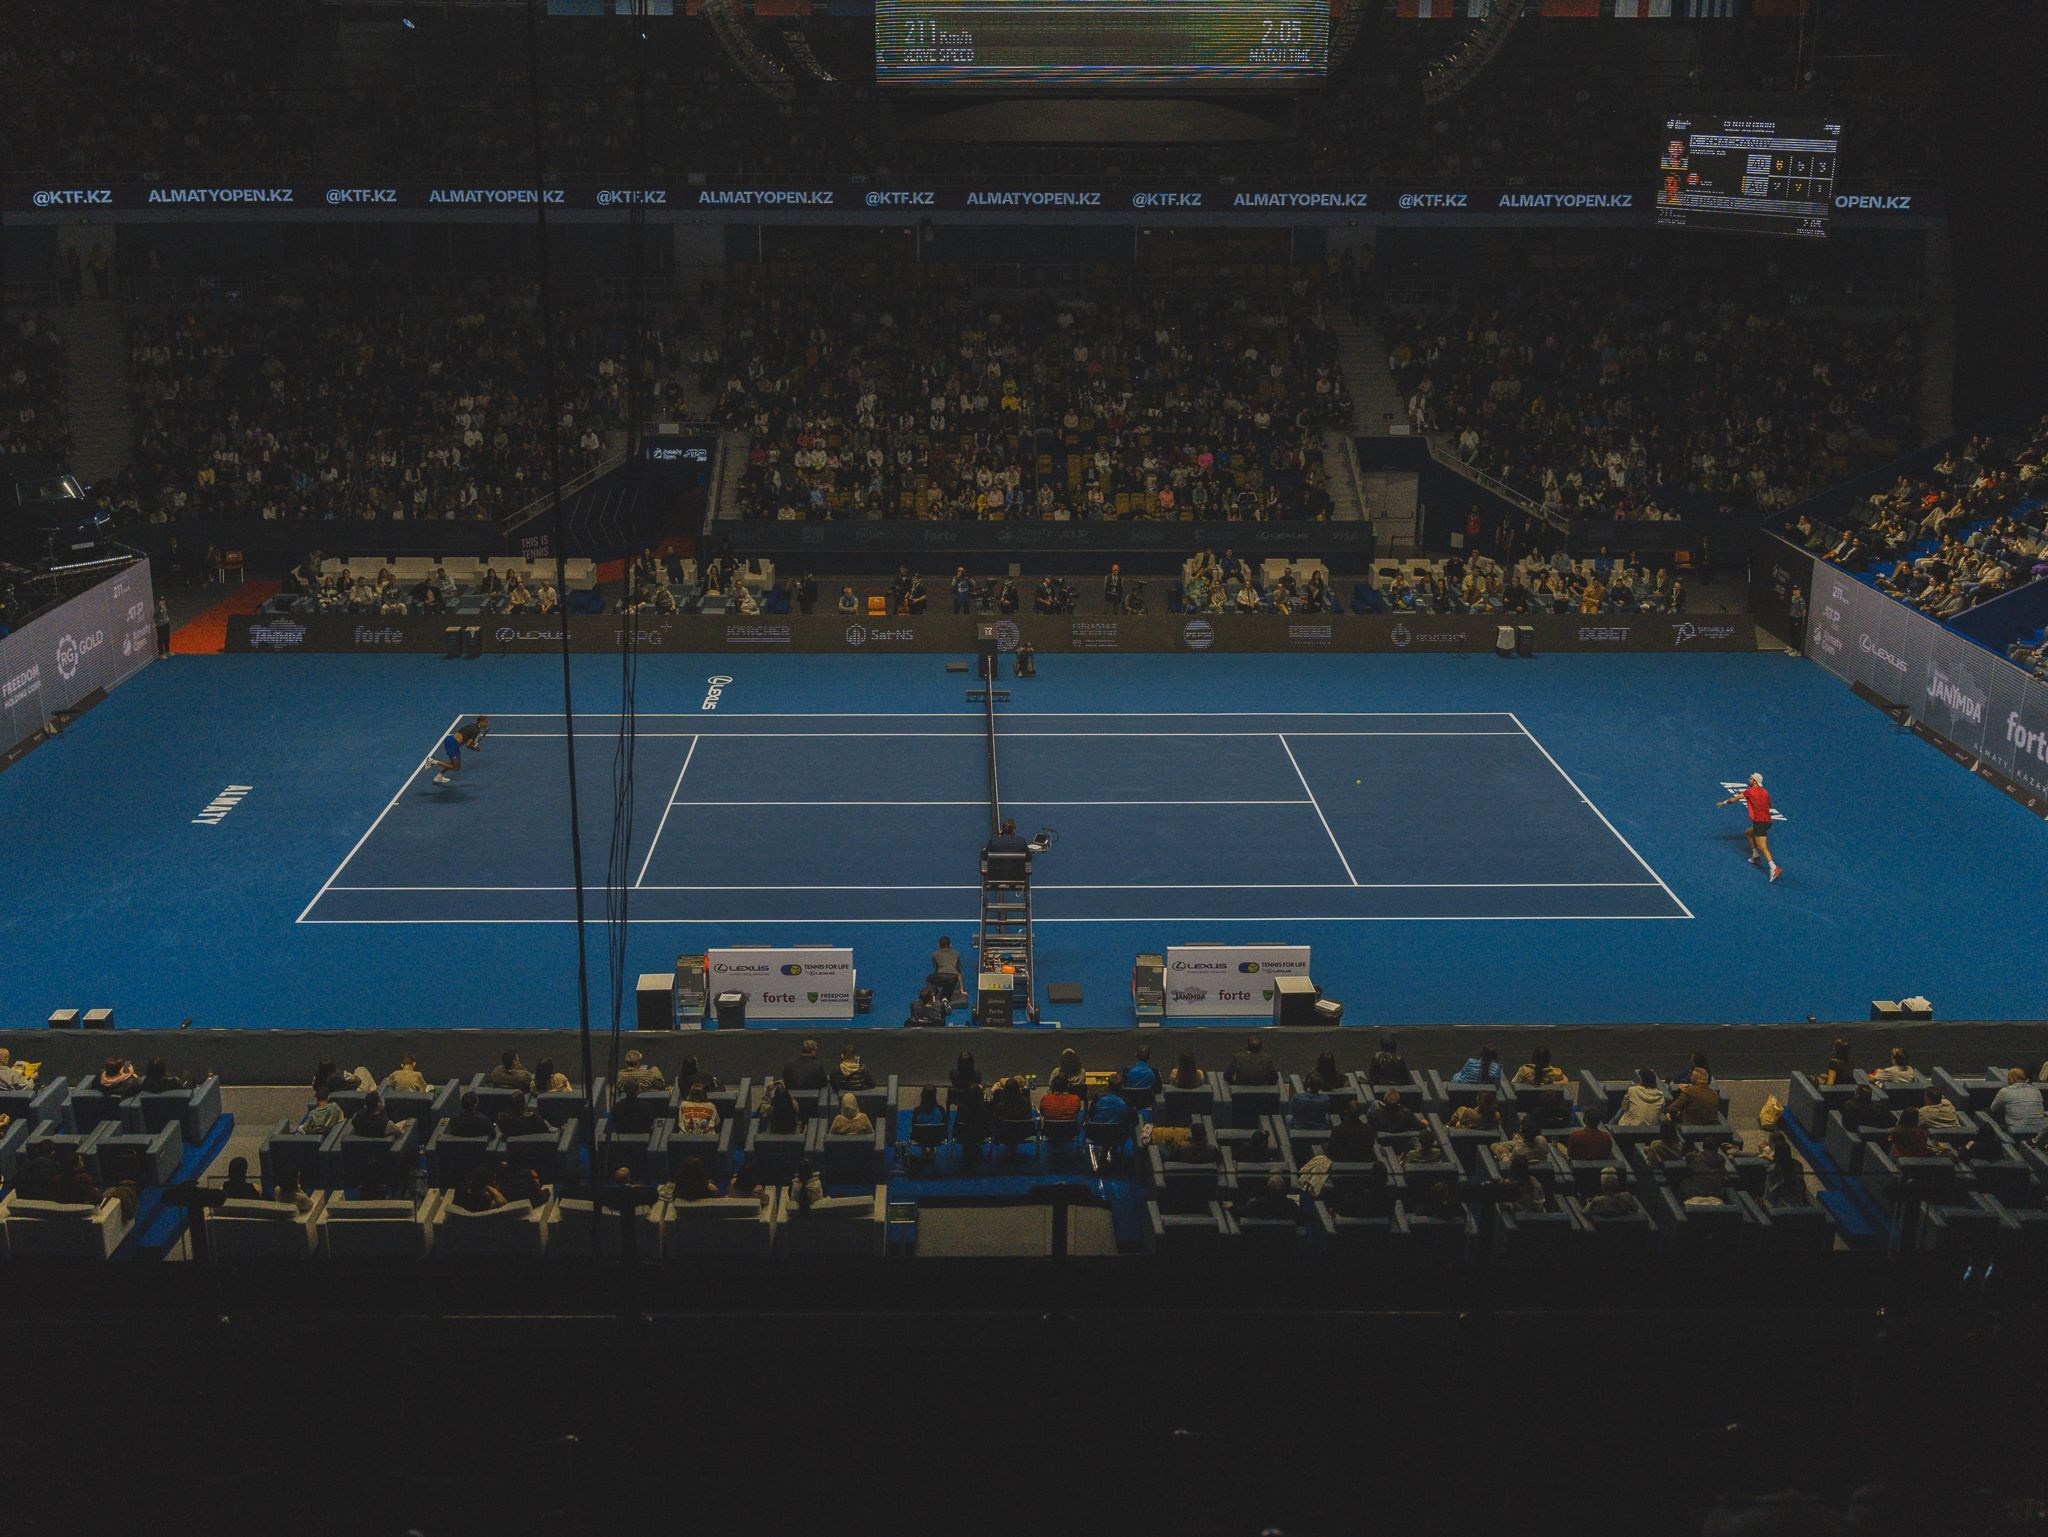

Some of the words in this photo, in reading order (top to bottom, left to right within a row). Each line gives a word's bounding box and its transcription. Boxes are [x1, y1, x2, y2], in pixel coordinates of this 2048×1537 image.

[904, 20, 936, 44] 211
[1262, 20, 1302, 44] 2:05
[904, 48, 937, 62] SERVE
[939, 48, 975, 62] SPEED
[1249, 48, 1286, 62] MATCH
[1289, 48, 1310, 62] TIME
[33, 190, 112, 207] @KTF.KZ
[149, 190, 294, 203] ALMATYOPEN.KZ
[327, 190, 397, 205] @KTF.KZ
[430, 190, 565, 203] ALMATYOPENKZ
[597, 190, 666, 206] @KTF.KZ
[699, 191, 834, 204] ALMATYOPEN.KZ
[866, 191, 935, 207] @KTF.KZ
[967, 192, 1101, 205] ALMATYOPEN.KZ
[1133, 192, 1202, 208] @KTF.KZ
[1234, 193, 1367, 206] ALMATYOPEN.KZ
[1399, 193, 1468, 209] @KTF.KZ
[1500, 194, 1633, 207] ALMATYOPEN.KZ
[1835, 195, 1912, 209] OPEN.KZ
[521, 536, 538, 548] THIS
[541, 534, 549, 545] IS
[522, 546, 549, 560] TENNIS
[355, 626, 403, 643] forte
[61, 648, 75, 668] RG
[79, 630, 103, 655] GOLD
[1871, 644, 1908, 672] LEXUS
[2, 664, 40, 697] FREEDOM
[702, 684, 725, 710] LEXUS
[2007, 711, 2048, 764] fort
[191, 784, 254, 825] ALMATY
[763, 992, 796, 1003] forte
[1218, 990, 1251, 1001] forte
